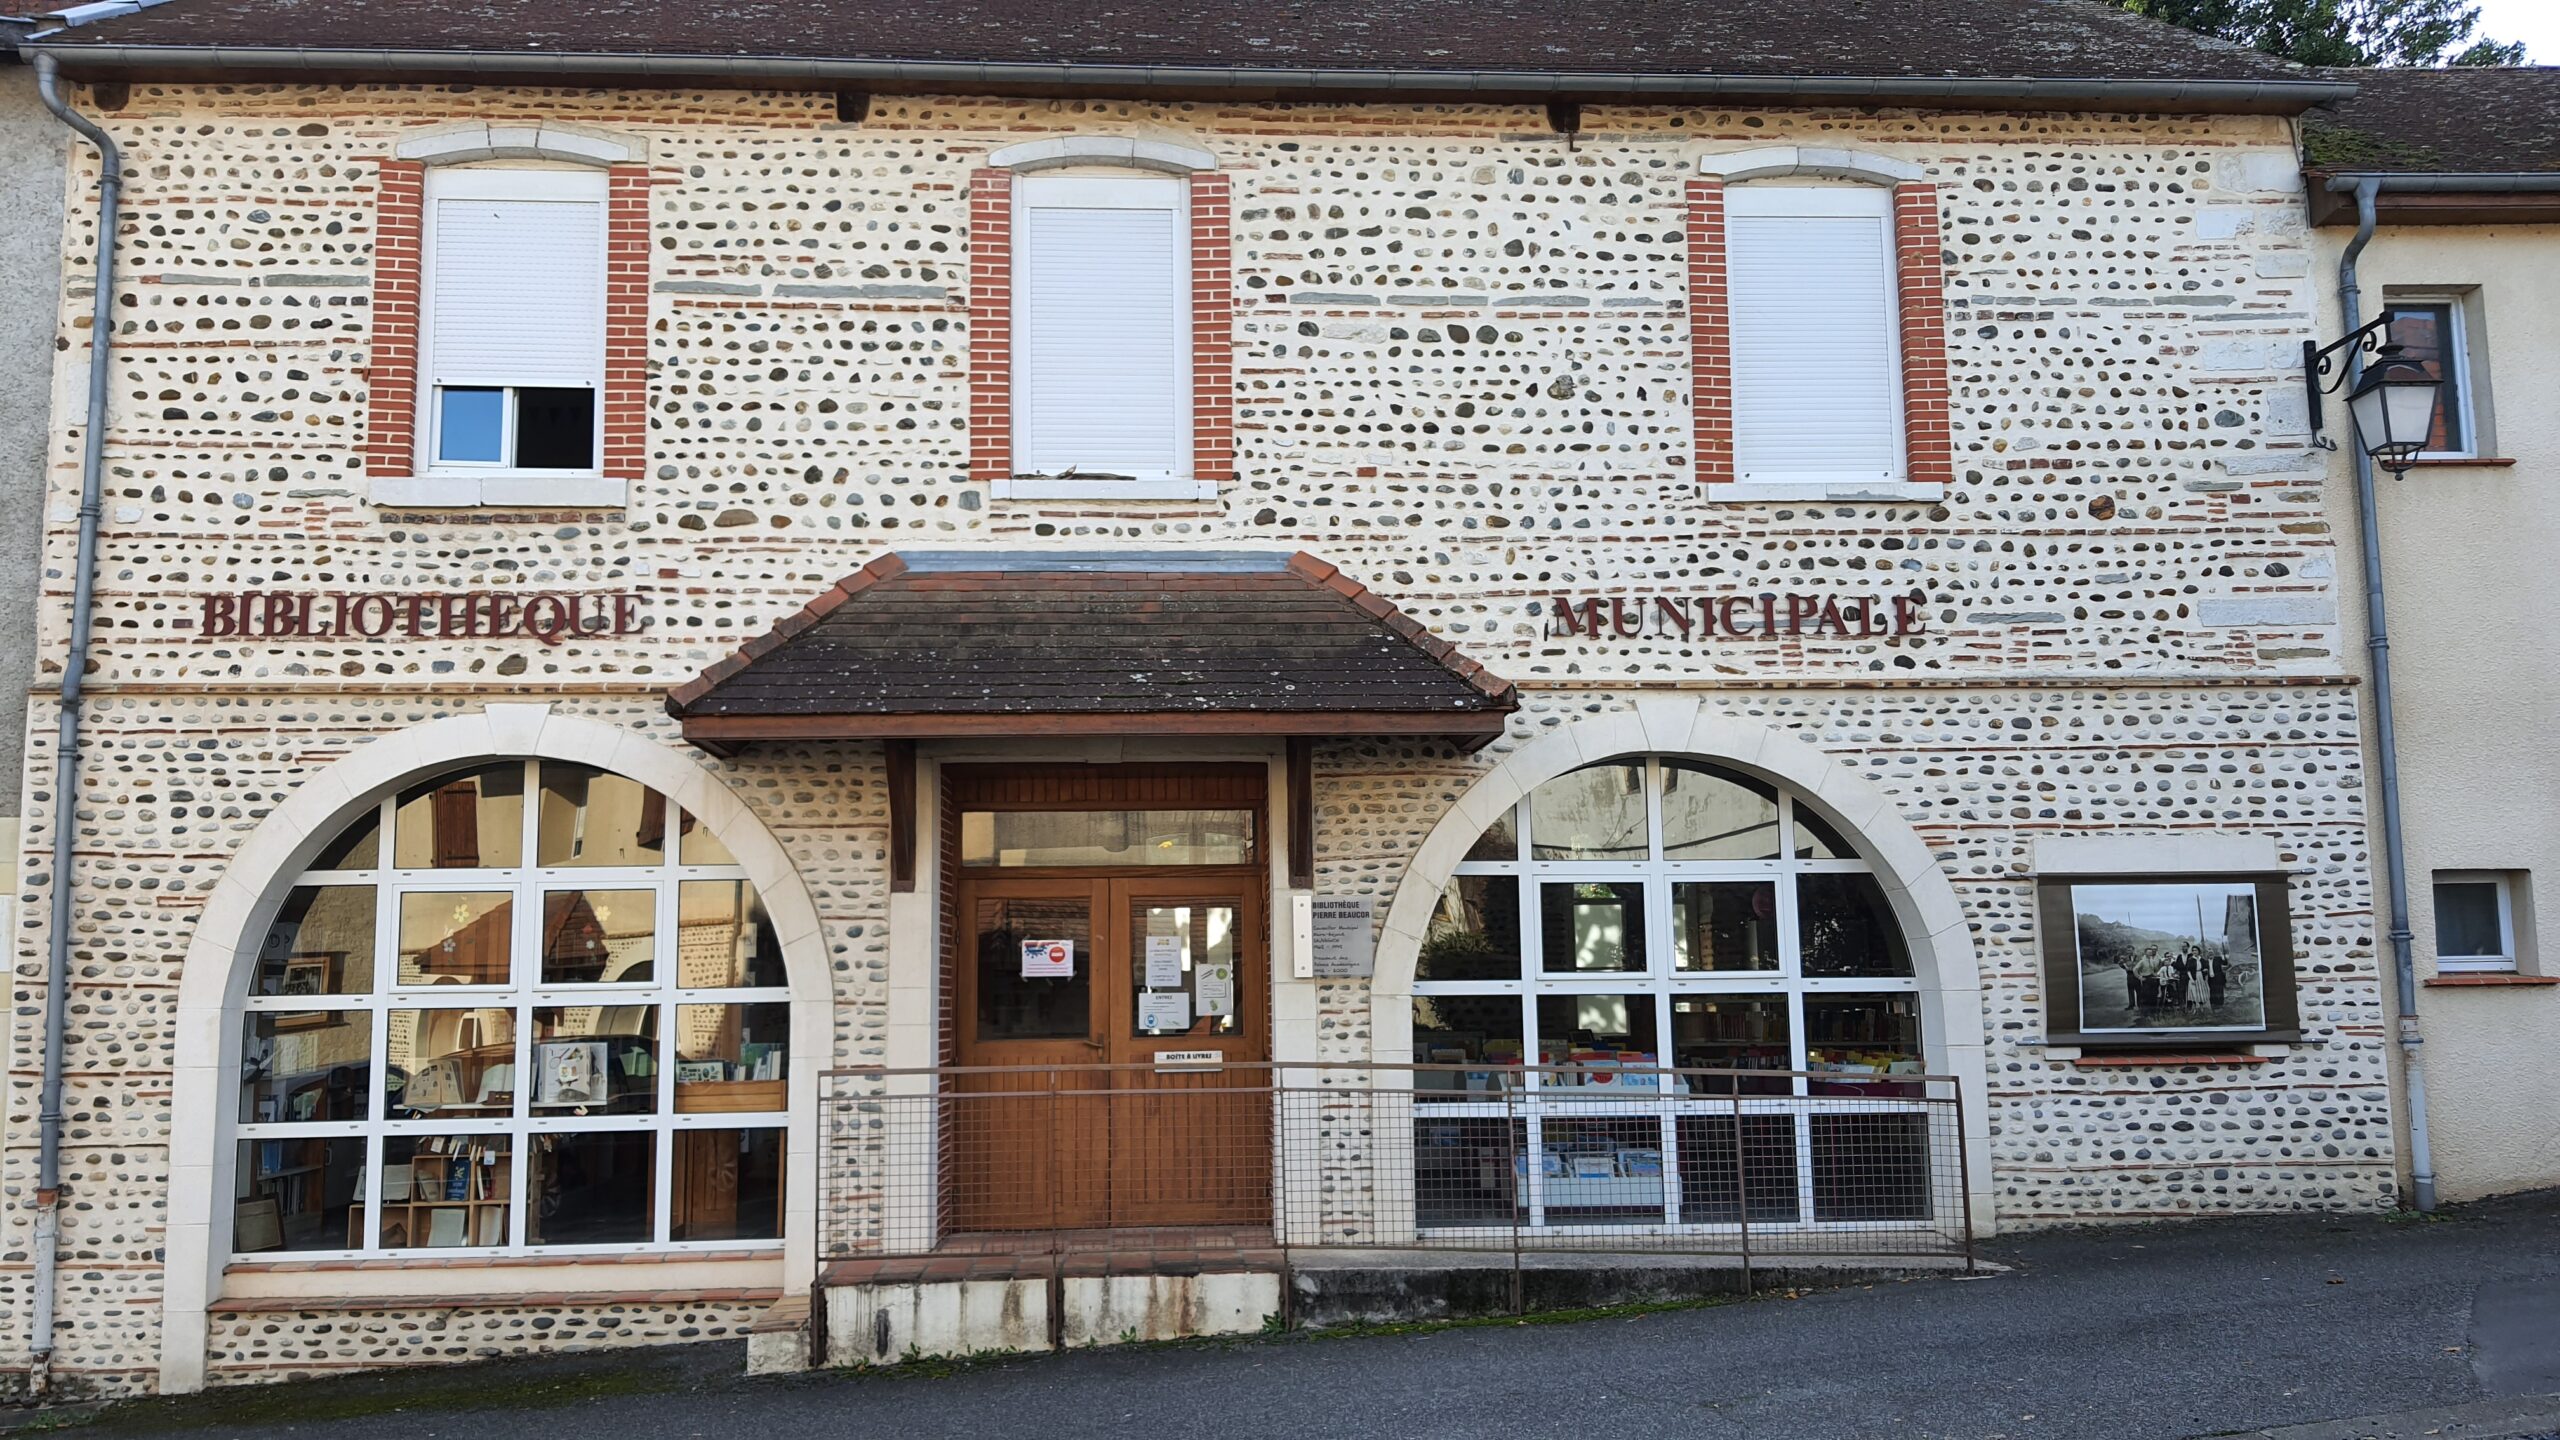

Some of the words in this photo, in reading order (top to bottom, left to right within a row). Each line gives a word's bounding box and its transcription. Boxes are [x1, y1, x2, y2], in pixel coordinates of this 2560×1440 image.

[199, 593, 645, 646] BIBLIOTHEQUE
[1550, 596, 1926, 636] MUNICIPALE
[1312, 900, 1360, 909] BIBLIOTHÈQUE
[1312, 911, 1337, 919] PIERRE
[1338, 911, 1370, 919] BEAUCOR
